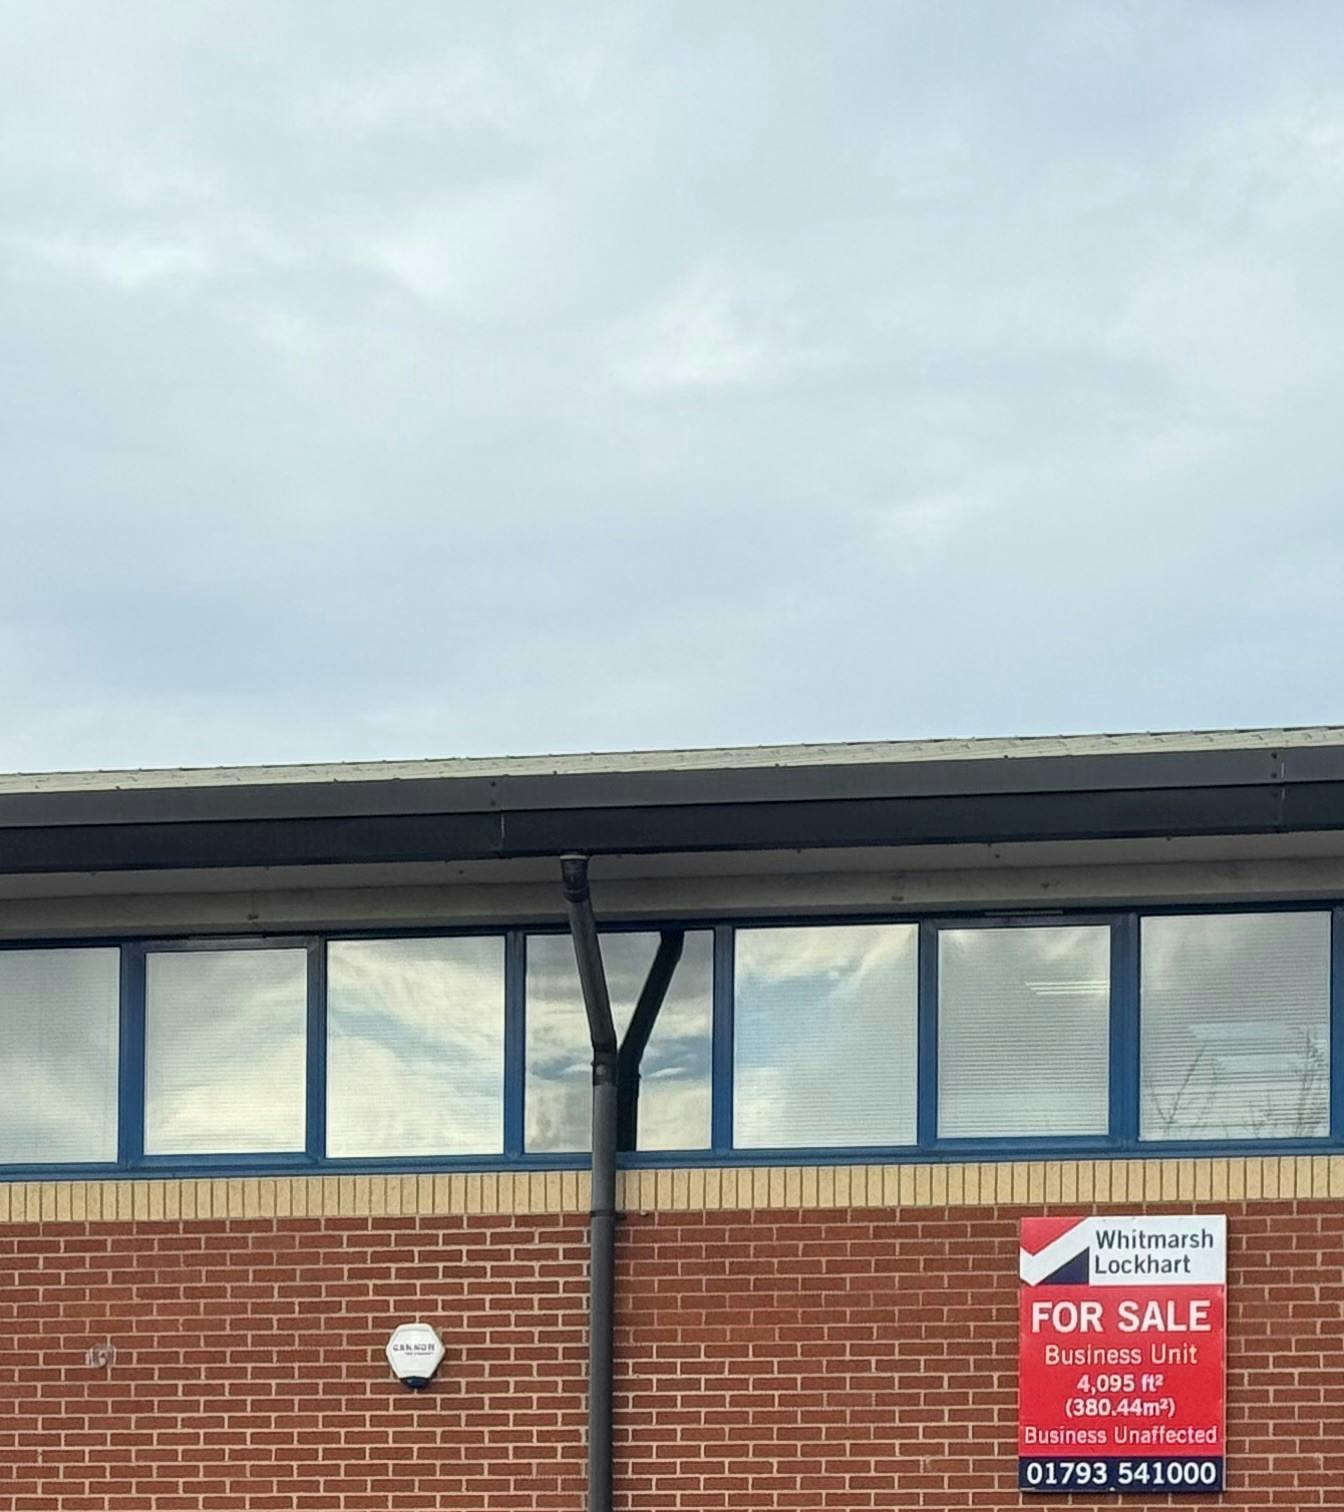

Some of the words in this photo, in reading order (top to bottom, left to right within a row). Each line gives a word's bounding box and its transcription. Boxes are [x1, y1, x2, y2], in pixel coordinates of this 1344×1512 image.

[1096, 1228, 1214, 1250] Whitmarsh
[1094, 1254, 1192, 1275] Lockhart
[1031, 1300, 1104, 1333] FOR
[1117, 1299, 1212, 1333] SALE
[1045, 1343, 1142, 1366] Business
[1151, 1342, 1198, 1365] Unit
[1076, 1374, 1136, 1396] 4,095
[1024, 1425, 1107, 1445] Business
[1114, 1424, 1218, 1445] Unaffected
[1026, 1461, 1108, 1485] 01793
[1117, 1461, 1217, 1485] 541000
